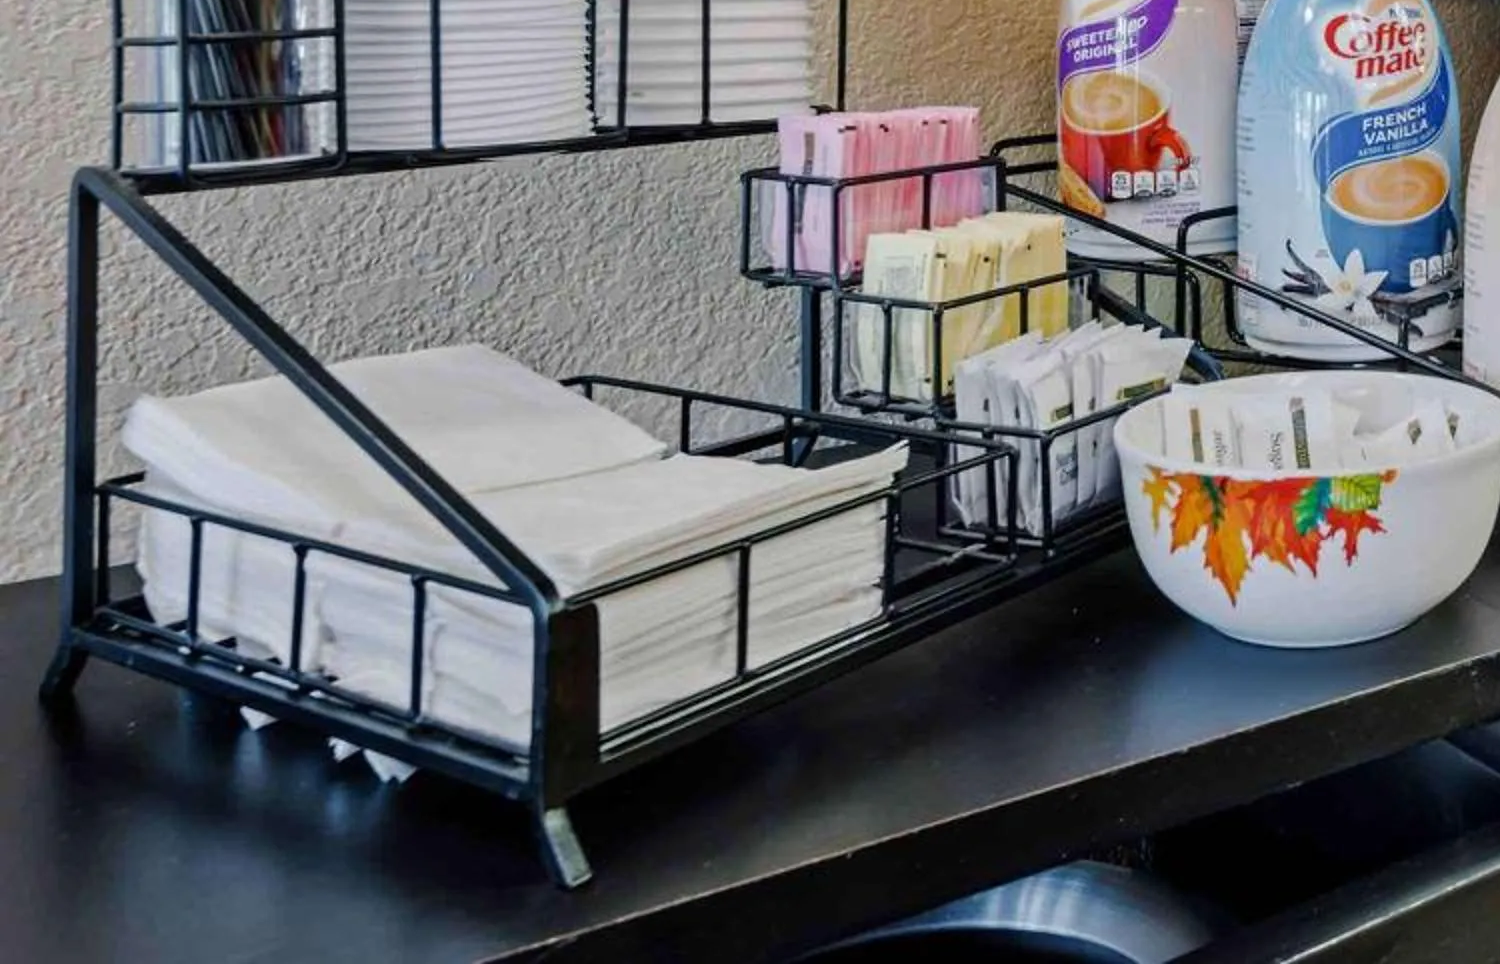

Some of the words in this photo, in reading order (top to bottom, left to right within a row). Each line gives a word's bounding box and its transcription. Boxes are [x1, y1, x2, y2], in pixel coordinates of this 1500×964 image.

[1324, 11, 1426, 60] Coffee
[1356, 47, 1425, 78] mate
[1363, 101, 1428, 132] FRENCH
[1364, 118, 1429, 145] VANILLA
